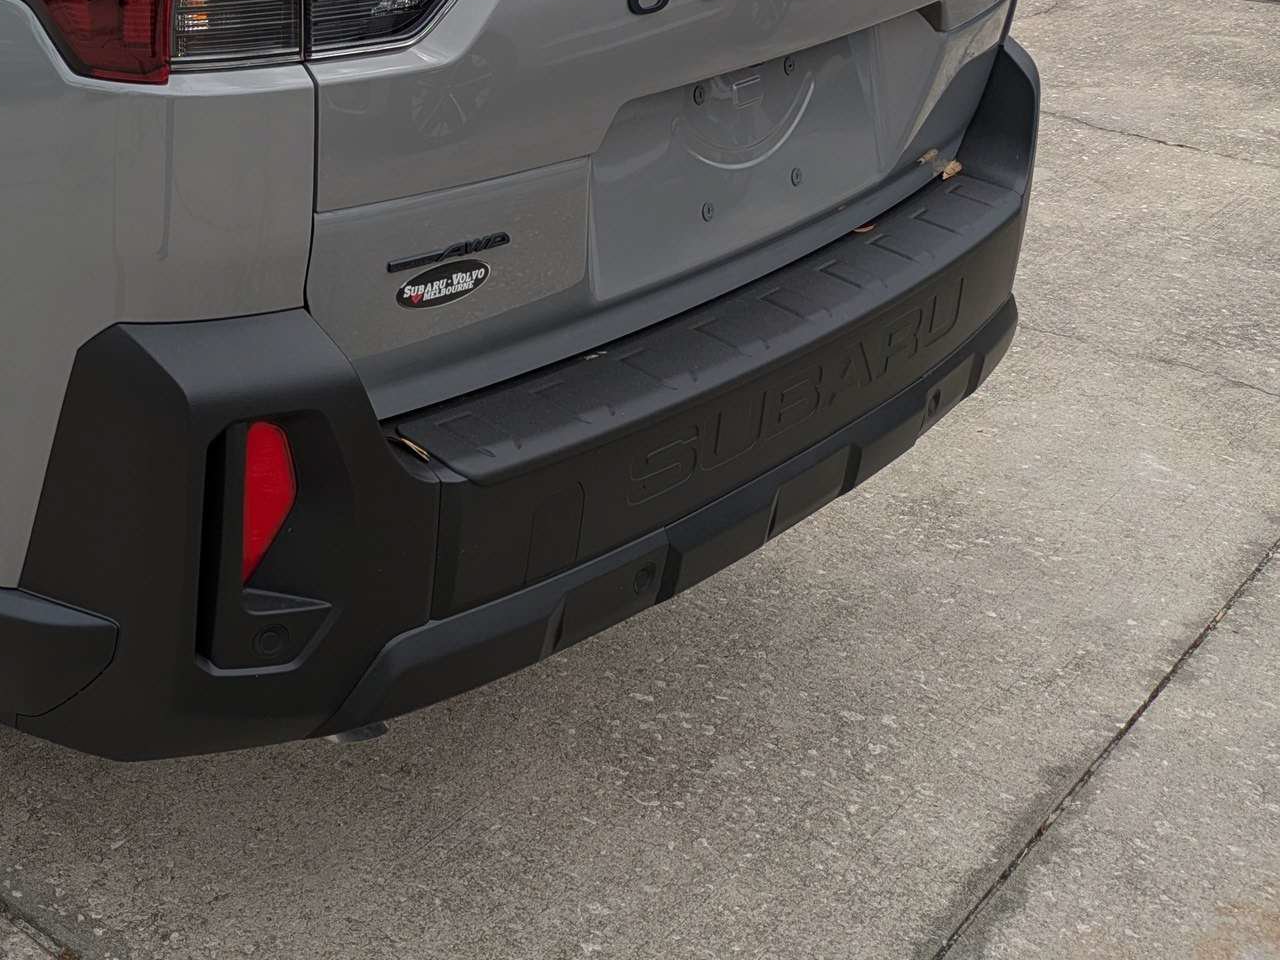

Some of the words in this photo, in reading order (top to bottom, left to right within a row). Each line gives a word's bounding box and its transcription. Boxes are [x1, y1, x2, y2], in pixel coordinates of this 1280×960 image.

[403, 278, 447, 298] SUBARU
[452, 268, 485, 286] VOLVO
[423, 281, 474, 301] MELBOURNE
[626, 276, 966, 507] SUBARU
